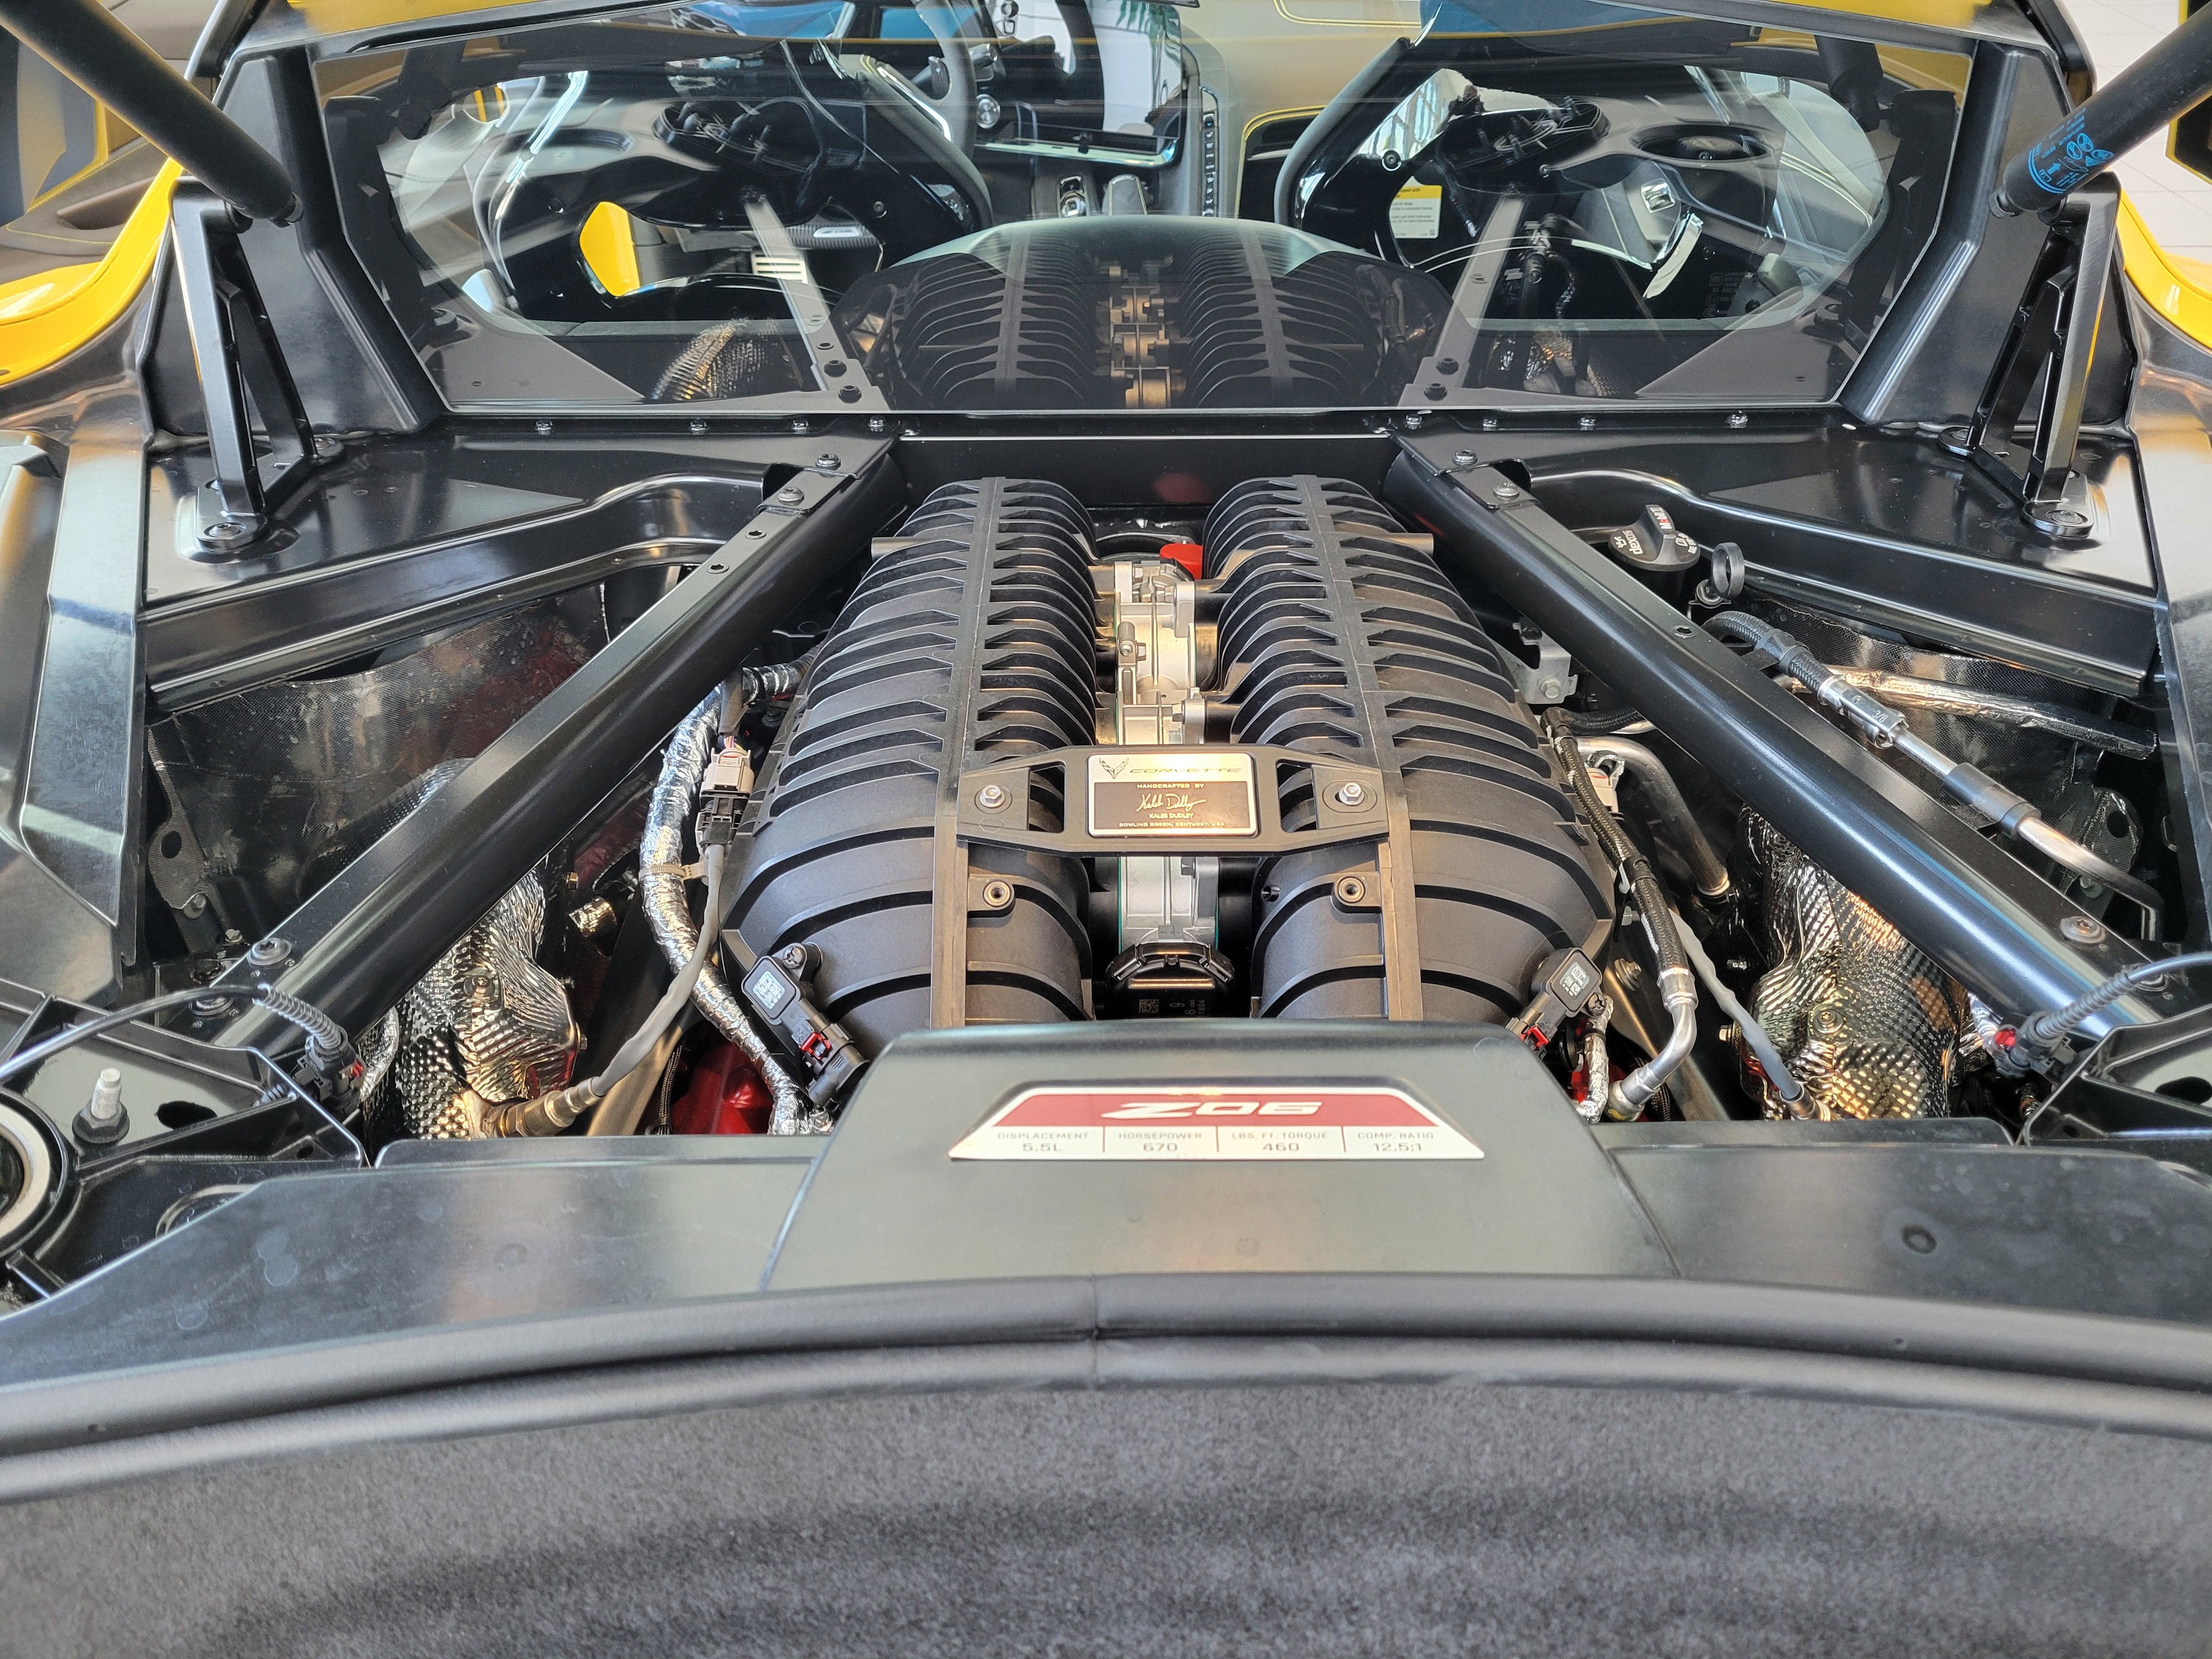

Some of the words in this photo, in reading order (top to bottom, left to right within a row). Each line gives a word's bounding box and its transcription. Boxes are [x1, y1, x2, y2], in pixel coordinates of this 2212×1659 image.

[1622, 530, 1644, 555] dexos
[1872, 710, 1888, 723] 3/8
[1101, 1102, 1323, 1120] Z06
[1023, 1143, 1063, 1152] 5.5L
[1143, 1143, 1178, 1152] 670
[1262, 1143, 1300, 1152] 460
[1373, 1143, 1423, 1152] 12.5:1
